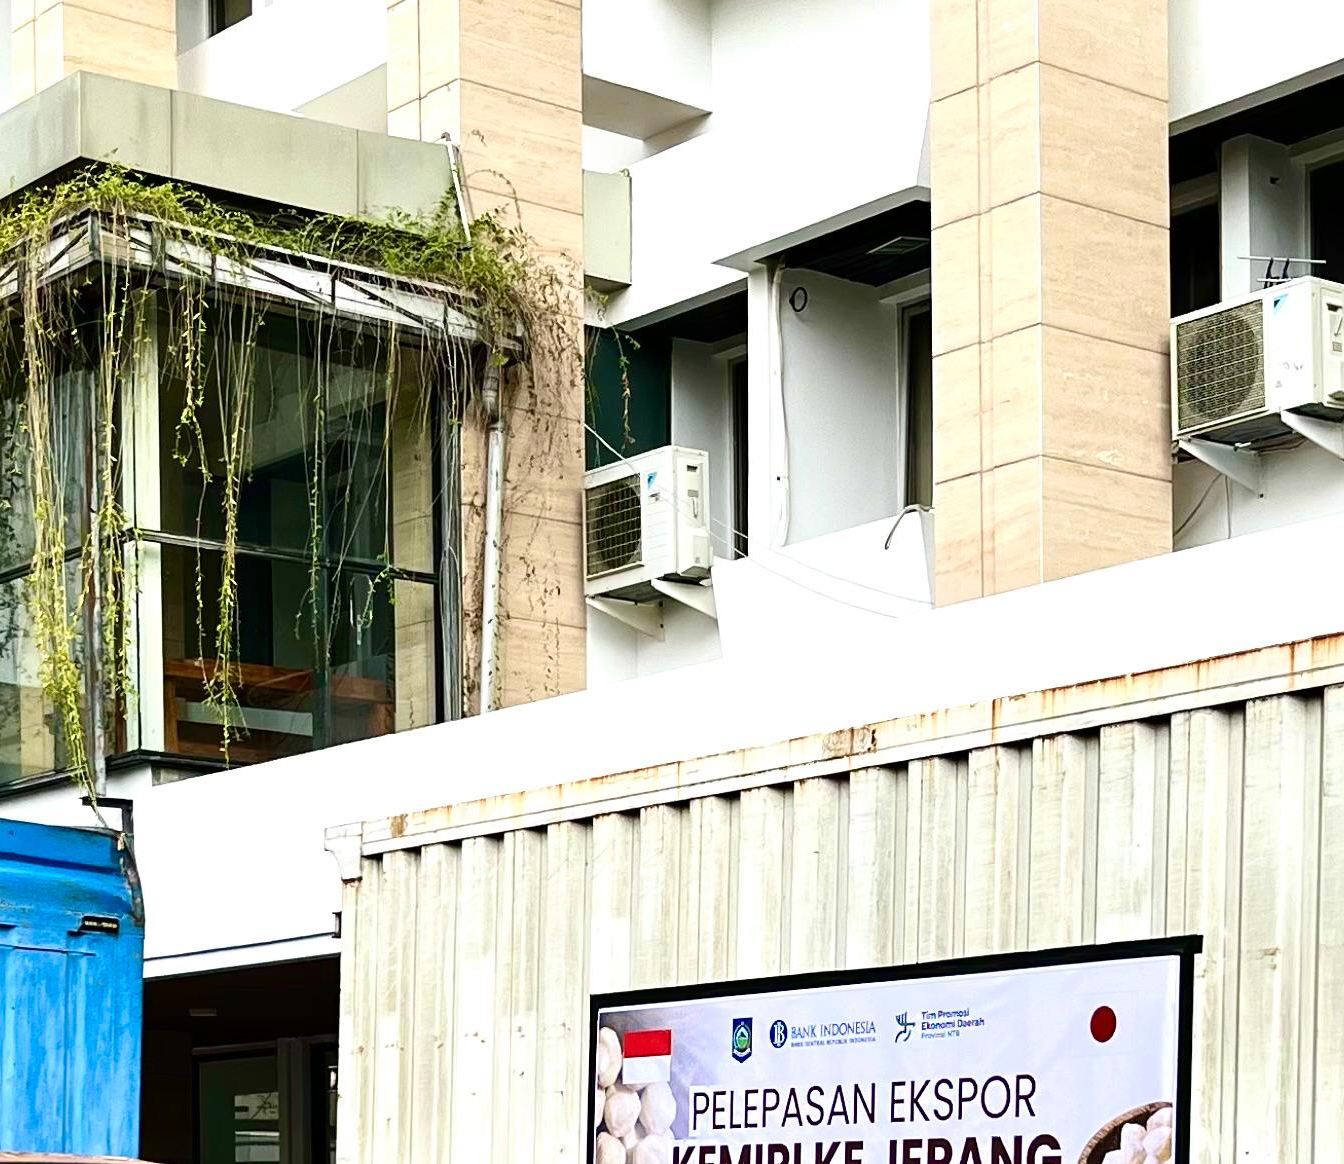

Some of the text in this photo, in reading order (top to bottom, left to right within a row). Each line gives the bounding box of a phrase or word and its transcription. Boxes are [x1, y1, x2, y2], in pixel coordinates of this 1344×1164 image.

[790, 1020, 876, 1039] BANK INDONESIA
[921, 1017, 985, 1031] Ekonomi Daerah
[692, 1074, 1037, 1130] PELEPASAN EKSPOR
